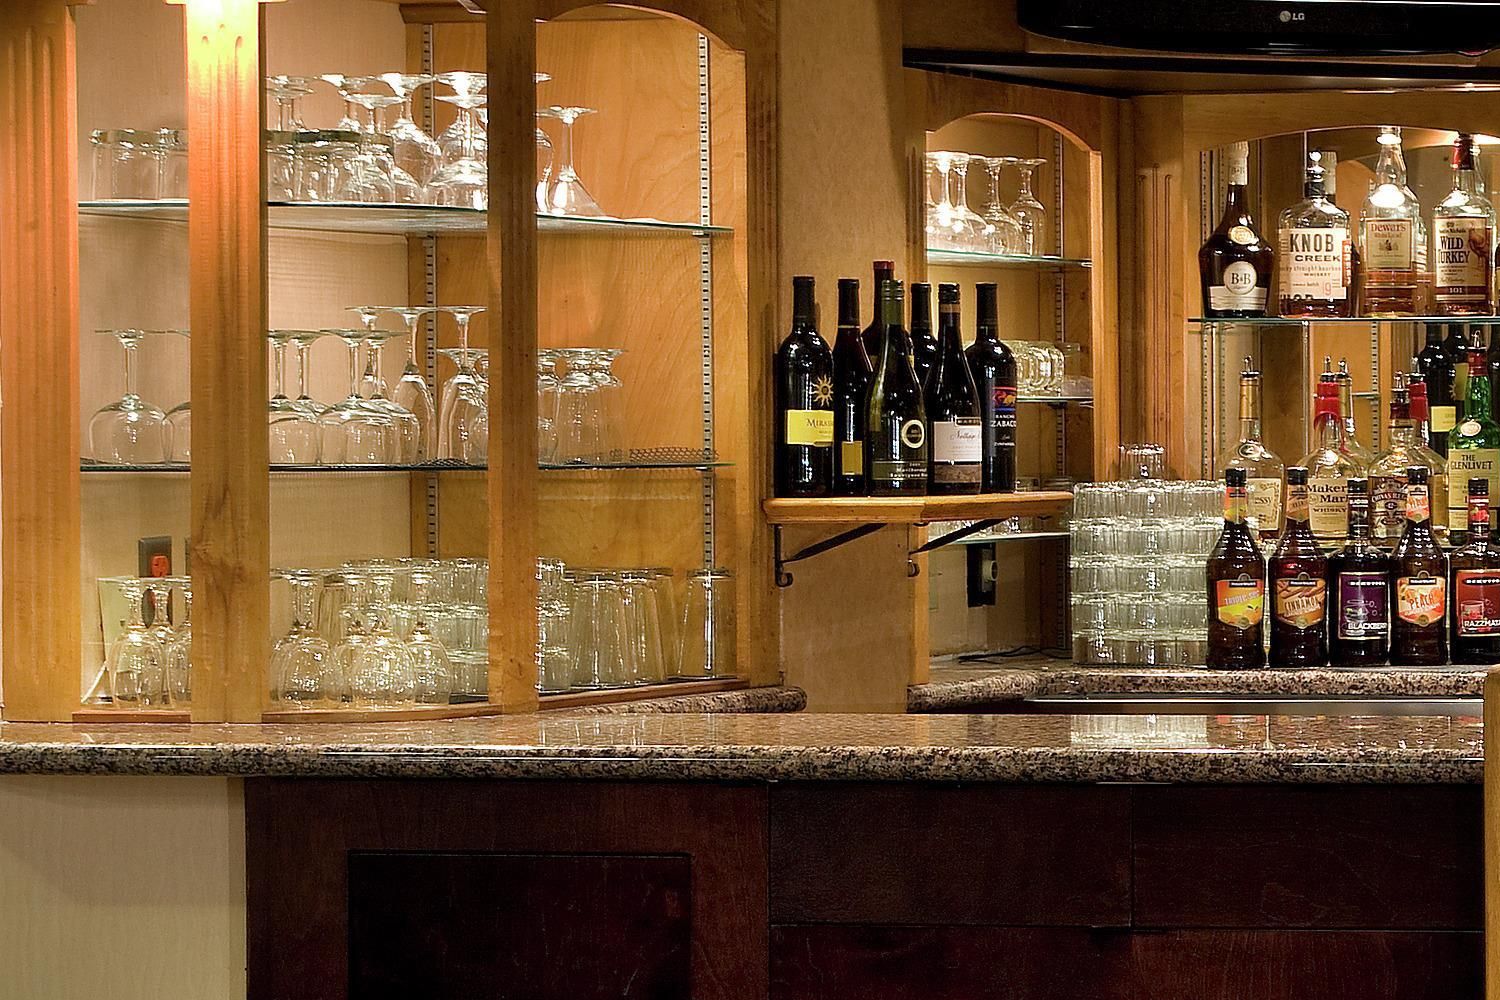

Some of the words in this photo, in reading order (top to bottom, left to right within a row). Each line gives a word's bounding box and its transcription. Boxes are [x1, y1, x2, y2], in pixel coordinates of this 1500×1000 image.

[1292, 12, 1305, 21] LG
[1289, 233, 1334, 252] KNOB
[1440, 236, 1463, 249] WILD
[1294, 254, 1341, 262] CREEK
[1449, 461, 1494, 470] GLENLIVET
